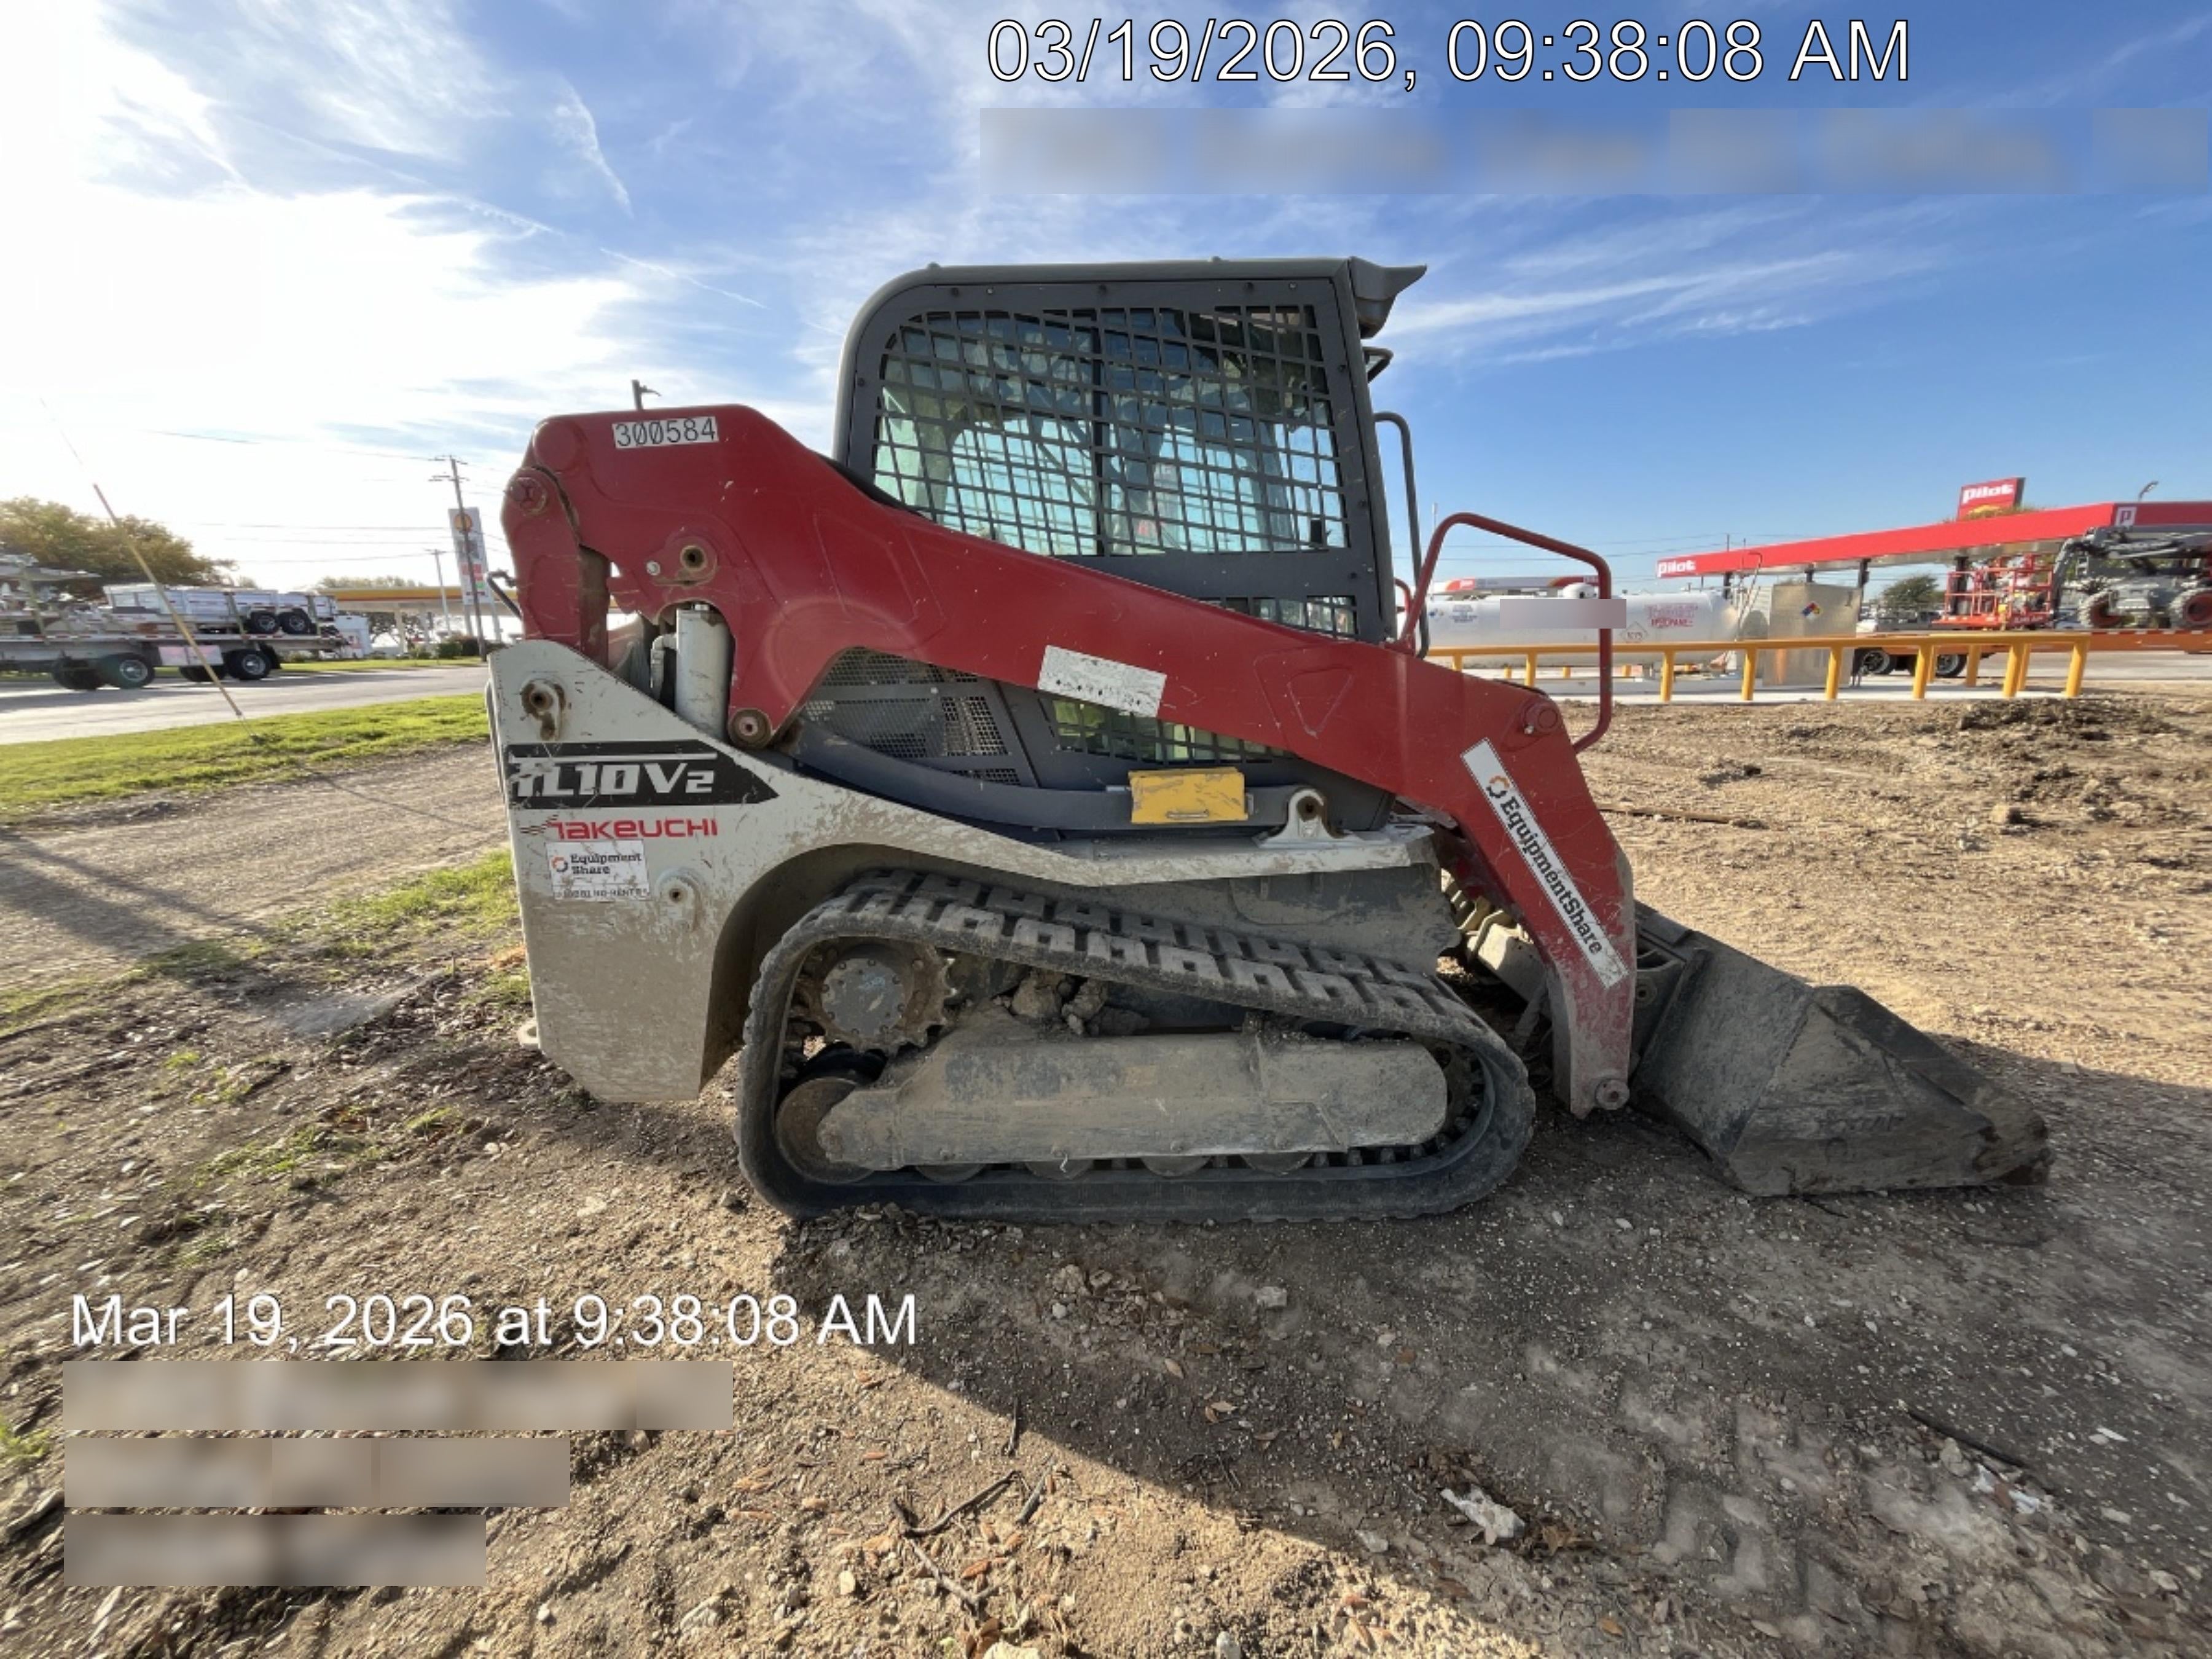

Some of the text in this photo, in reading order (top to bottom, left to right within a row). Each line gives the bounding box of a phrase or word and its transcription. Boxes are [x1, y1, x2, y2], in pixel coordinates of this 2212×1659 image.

[615, 417, 715, 447] 300584
[570, 853, 642, 865] Equipment
[571, 866, 610, 874] Share
[1499, 796, 1603, 955] EquipmentShare
